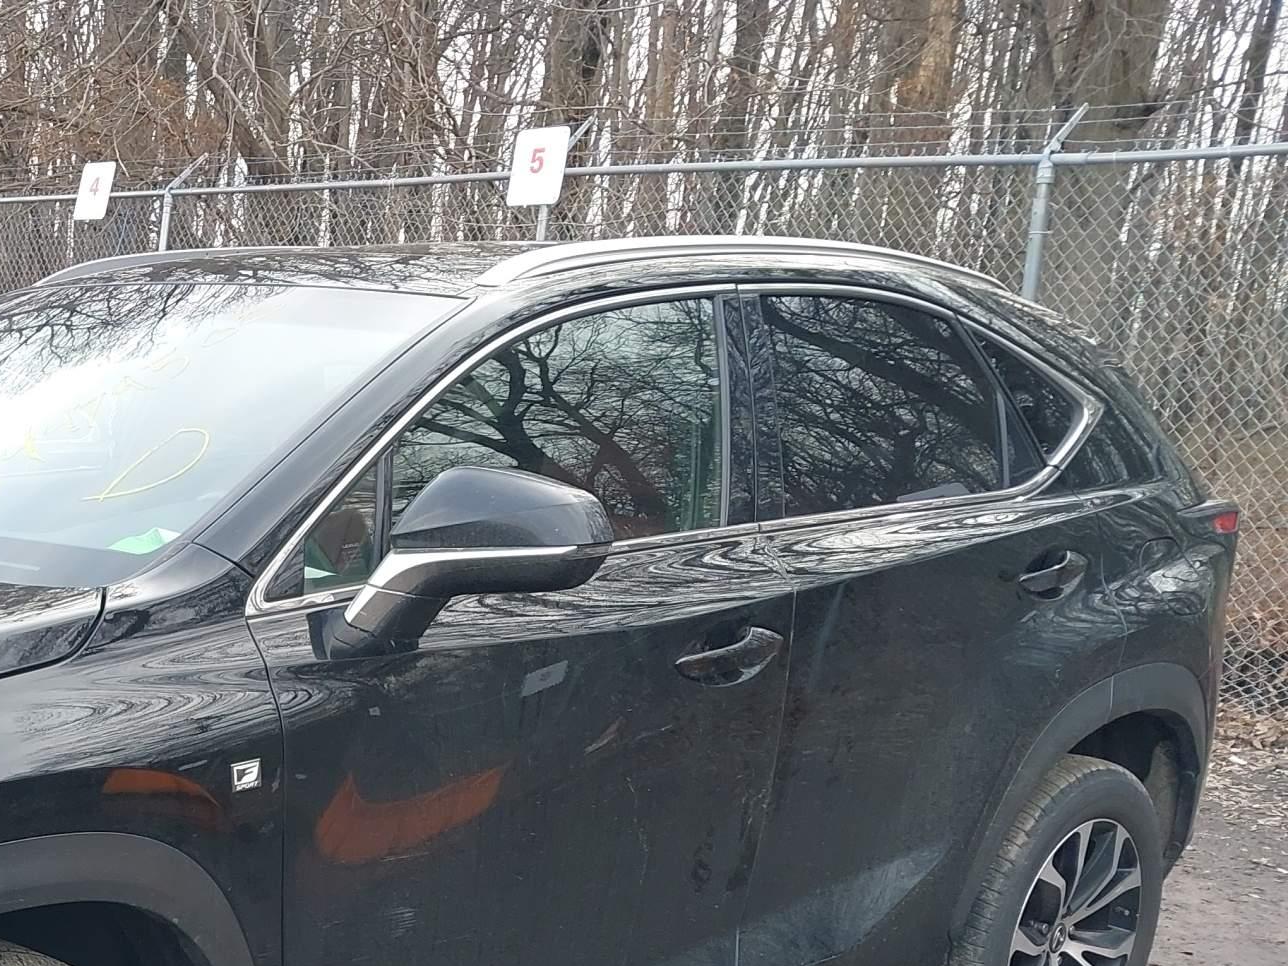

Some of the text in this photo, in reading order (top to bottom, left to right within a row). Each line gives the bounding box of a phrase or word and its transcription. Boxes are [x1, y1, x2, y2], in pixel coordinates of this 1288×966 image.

[529, 147, 546, 174] 5
[89, 176, 101, 197] 4
[235, 781, 259, 791] SPORT
